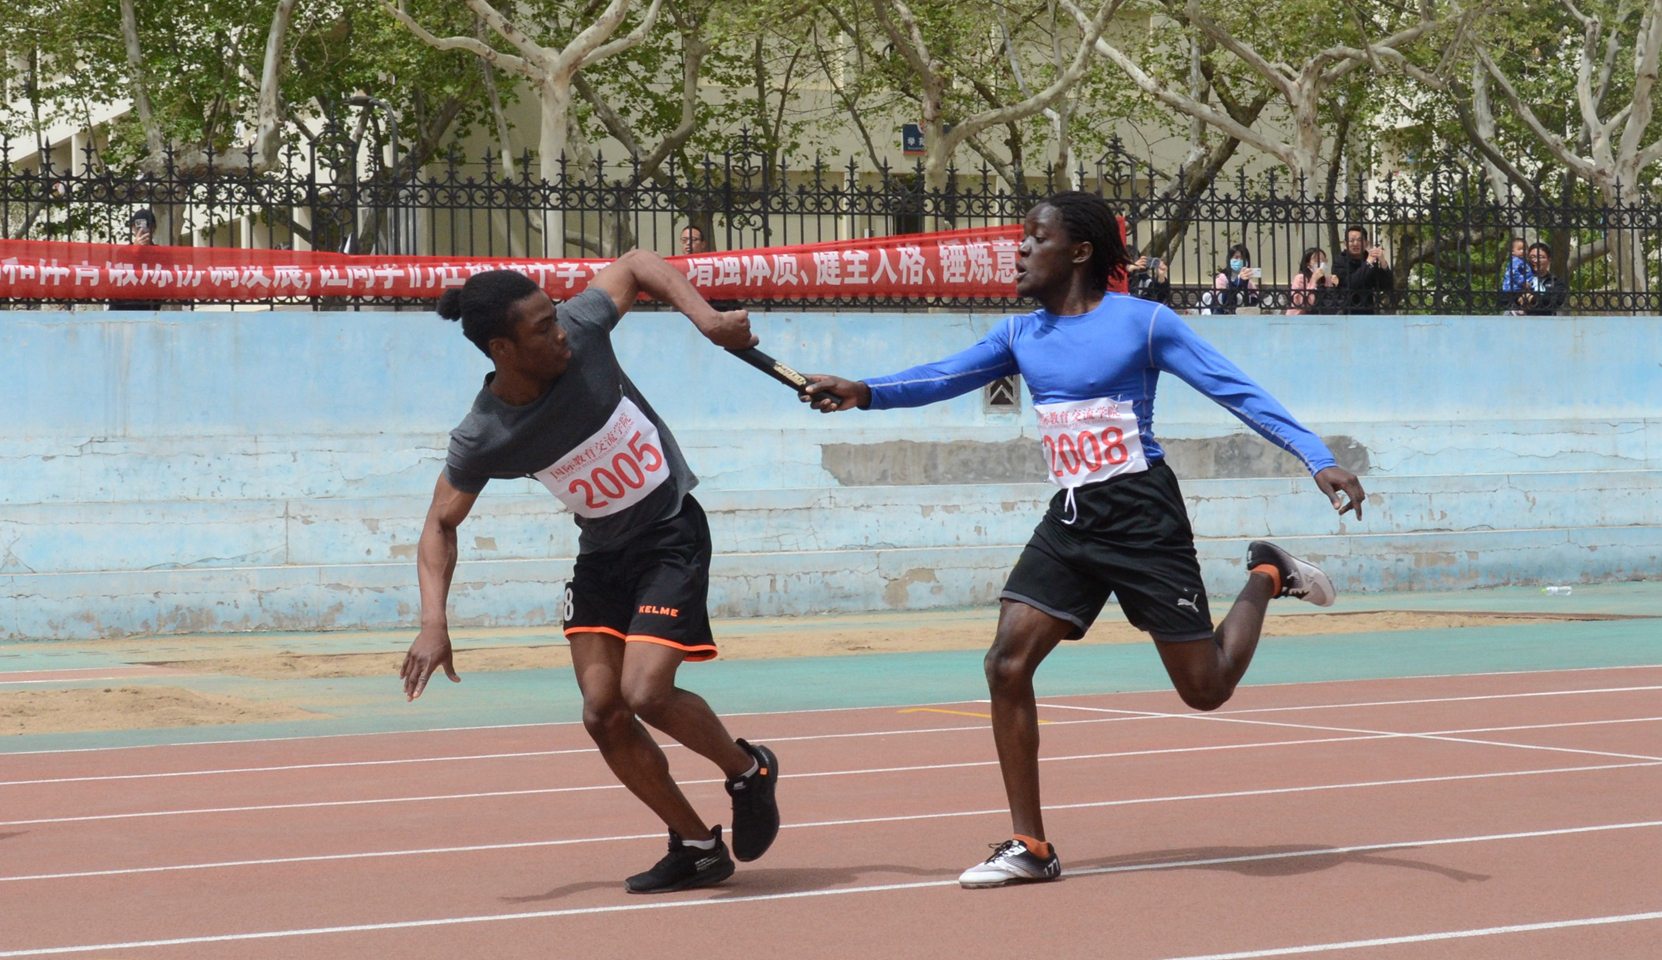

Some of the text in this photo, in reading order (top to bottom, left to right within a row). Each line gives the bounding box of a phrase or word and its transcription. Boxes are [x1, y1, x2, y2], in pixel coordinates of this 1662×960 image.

[549, 412, 632, 480] 国际教育交流学院
[568, 430, 663, 509] 2005
[1043, 426, 1128, 477] 2008
[638, 605, 679, 617] KELME
